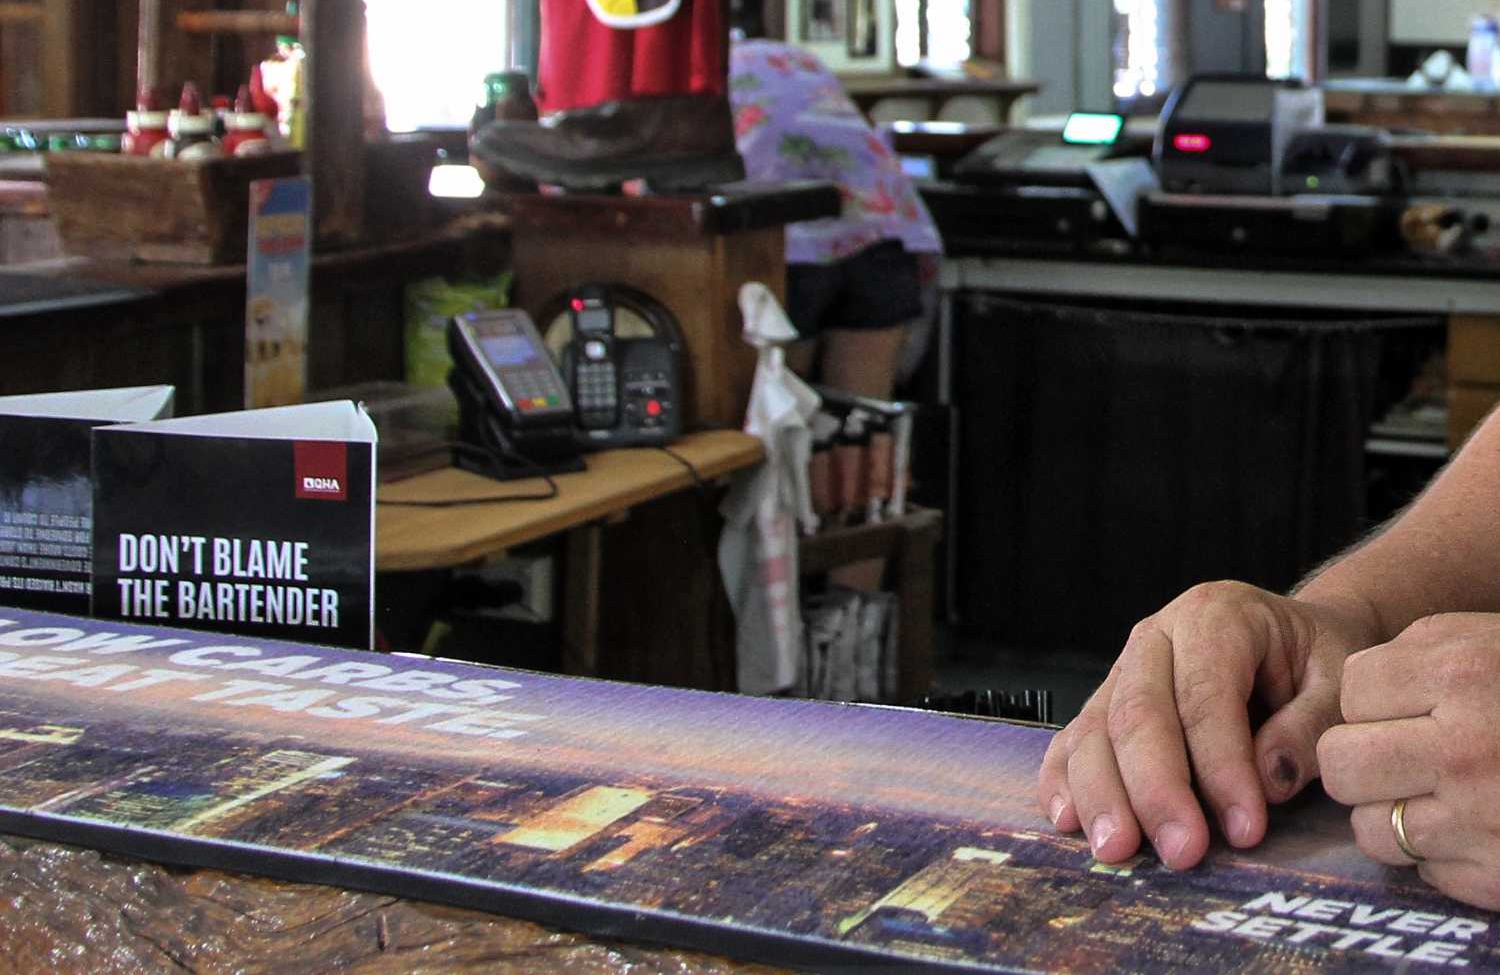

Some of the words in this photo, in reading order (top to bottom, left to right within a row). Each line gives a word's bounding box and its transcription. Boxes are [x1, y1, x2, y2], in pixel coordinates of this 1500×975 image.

[118, 533, 207, 575] DON'T
[213, 537, 309, 581] BLAME
[117, 578, 170, 617] THE
[178, 580, 339, 627] BARTENDER
[0, 619, 194, 654] OW
[1191, 910, 1471, 967] SETTLE.
[1242, 891, 1489, 940] NEVER
